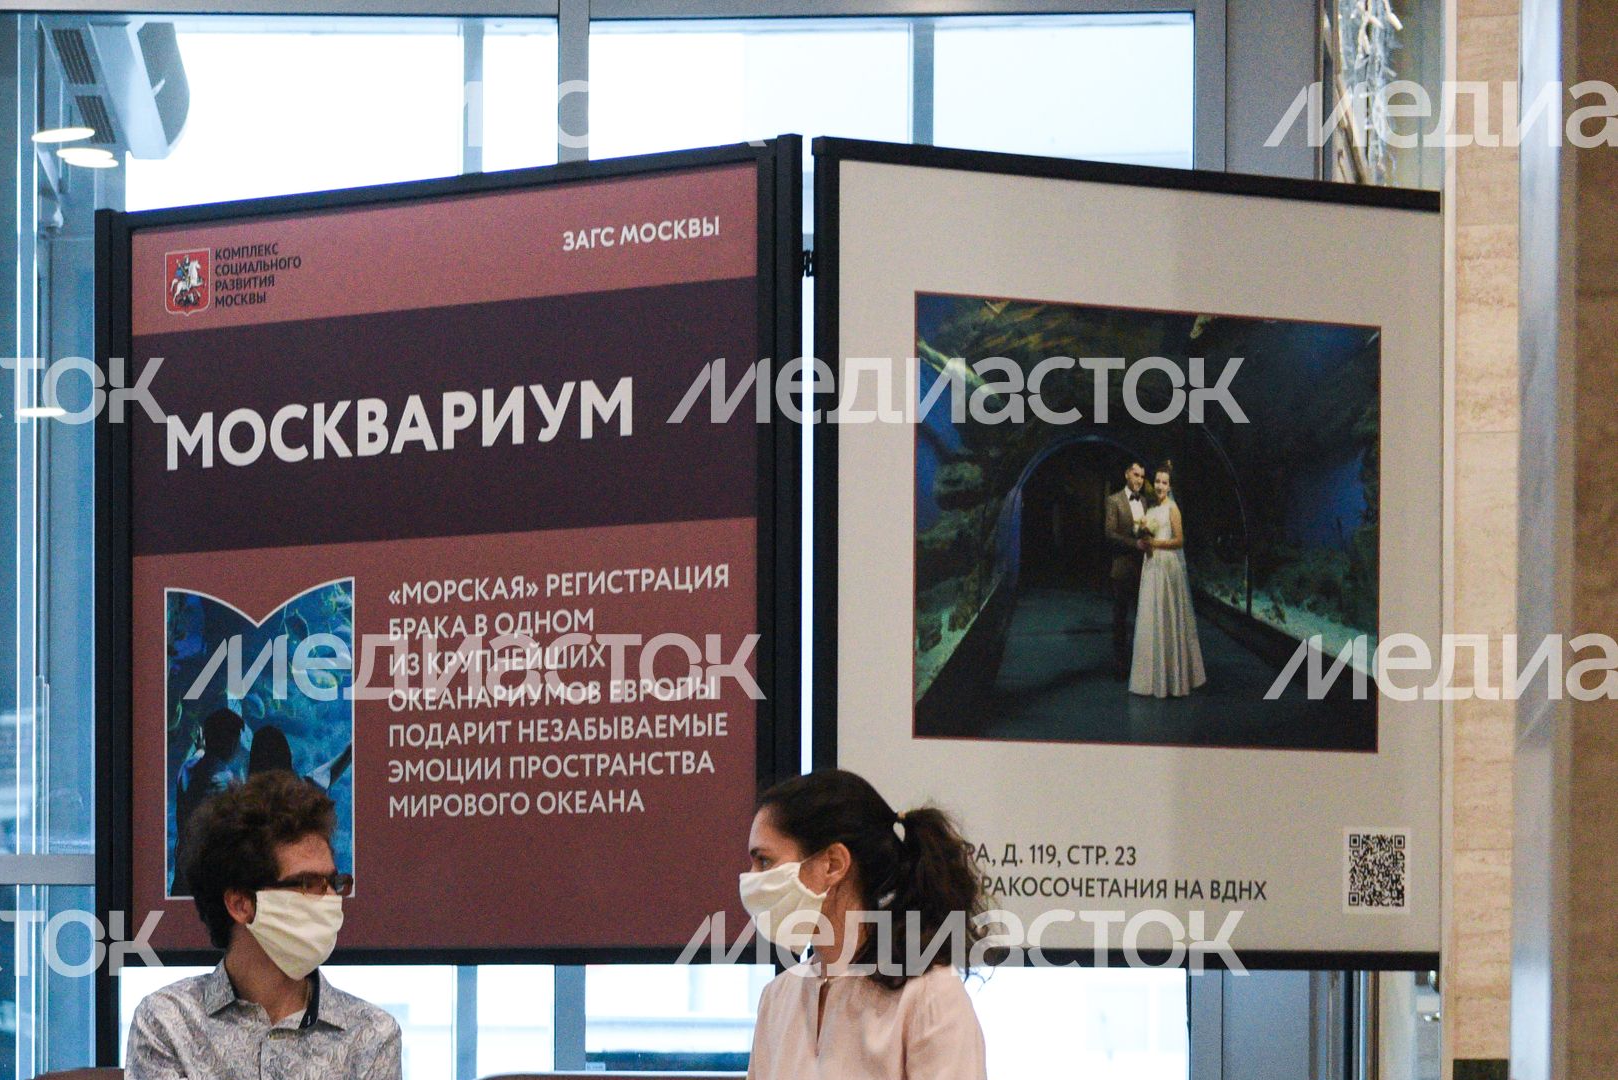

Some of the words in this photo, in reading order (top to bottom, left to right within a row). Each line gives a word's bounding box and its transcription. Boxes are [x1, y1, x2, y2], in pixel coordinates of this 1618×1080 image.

[214, 241, 279, 260] КОМПЛЕКС
[562, 224, 615, 252] ЗАГС
[620, 216, 719, 245] МОСКВЫ
[214, 256, 302, 276] СОЦИАЛЬНОГО
[214, 274, 275, 292] РАЗВИТИЯ
[214, 291, 267, 308] МОСКВЫ
[166, 376, 634, 471] МОСКВАРИУМ
[388, 575, 539, 606] «МОРСКАЯ»
[546, 564, 730, 598] РЕГИСТРАЦИЯ
[388, 617, 468, 641] БРАКА
[475, 614, 487, 635] В
[495, 608, 594, 638] ОДНОМ
[389, 653, 419, 677] ИЗ
[427, 640, 606, 675] КРУПНЕЙШИХ
[388, 679, 600, 712] ОКЕАНАРИУМОВ
[609, 675, 715, 704] ЕВРОПЫ
[388, 721, 510, 749] ПОДАРИТ
[518, 713, 729, 744] НЕЗАБЫВАЕМЫЕ
[388, 755, 501, 785] ЭМОЦИИ
[509, 750, 714, 780] ПРОСТРАНСТВА
[388, 791, 530, 819] МИРОВОГО
[536, 789, 644, 814] ОКЕАНА
[964, 842, 996, 866] РА,
[1001, 844, 1023, 866] Д.
[1030, 844, 1061, 868] 119,
[1067, 845, 1111, 867] СТР.
[1115, 845, 1137, 867] 23
[980, 873, 1169, 900] РАКОСОЧЕТАНИЯ
[1174, 877, 1205, 900] НА
[1210, 877, 1267, 904] ВДНХ
